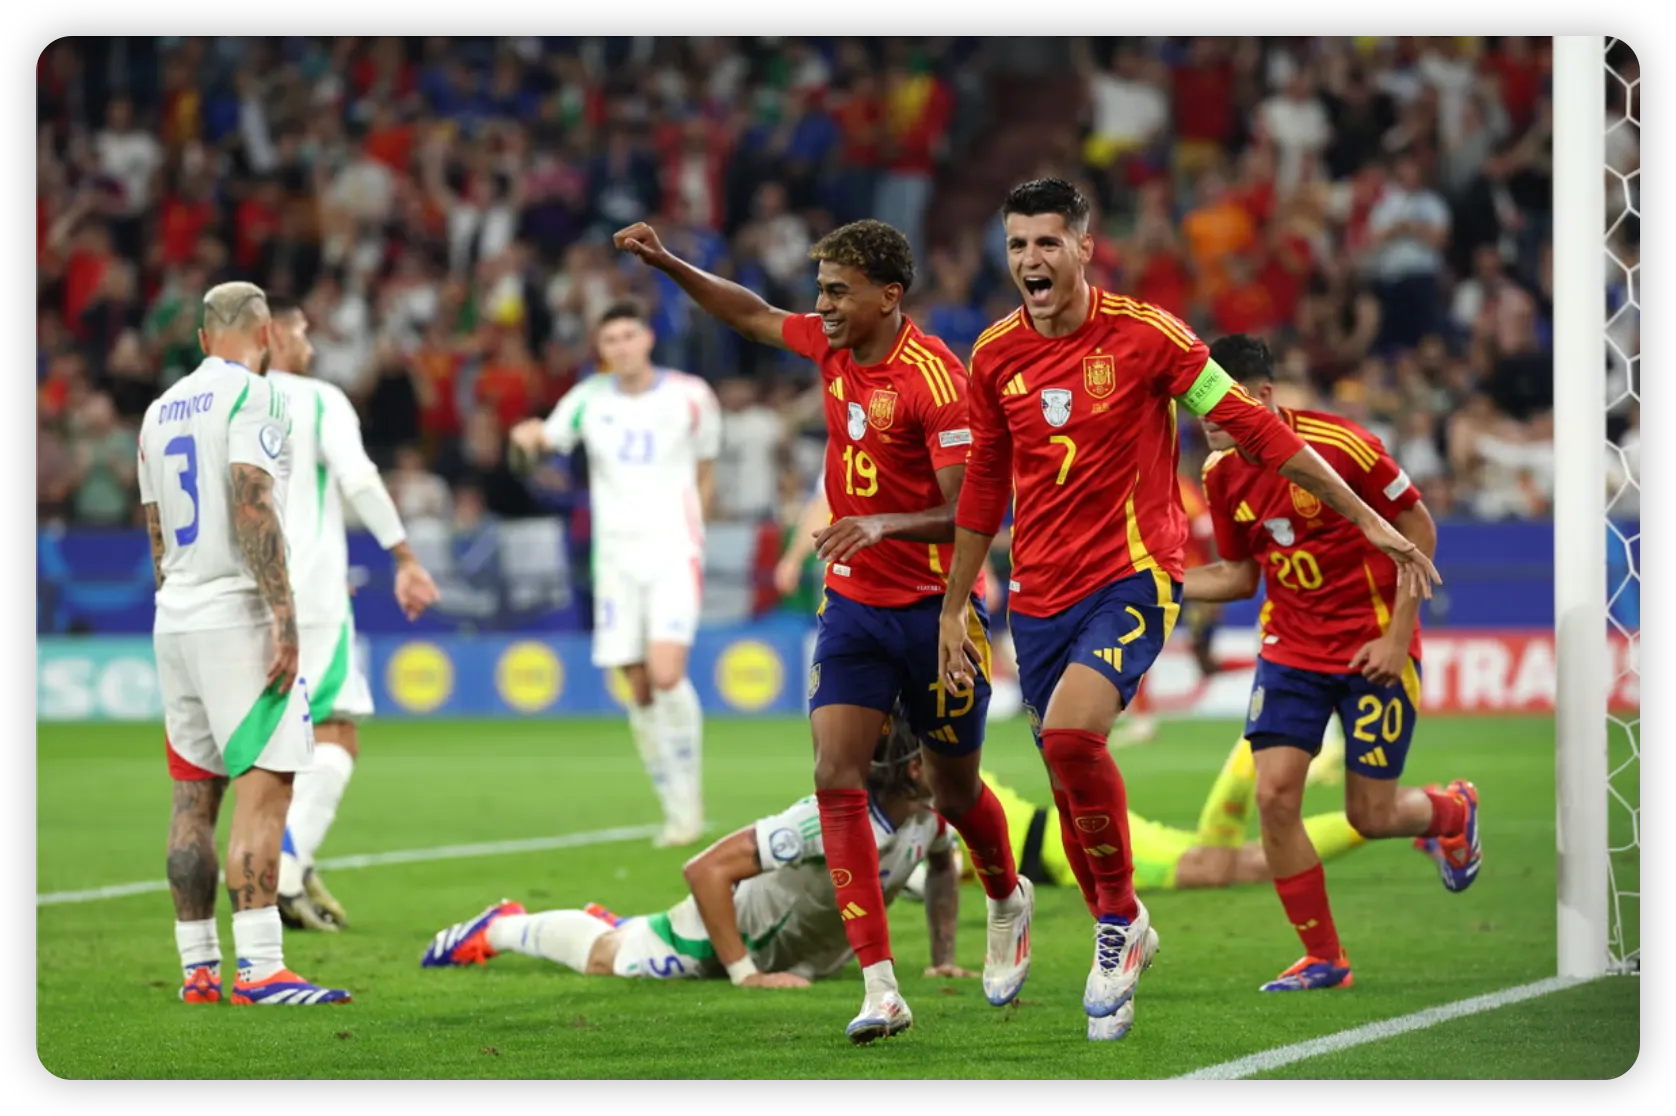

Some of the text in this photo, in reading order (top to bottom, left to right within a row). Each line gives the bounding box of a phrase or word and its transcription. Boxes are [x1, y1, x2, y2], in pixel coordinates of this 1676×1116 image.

[1195, 371, 1220, 399] RESPEC
[843, 445, 878, 497] 19
[1050, 435, 1077, 485] 7
[164, 434, 198, 547] 3
[1270, 550, 1323, 589] 20
[1118, 605, 1146, 645] 7
[929, 675, 974, 718] 19
[1353, 694, 1402, 743] 20
